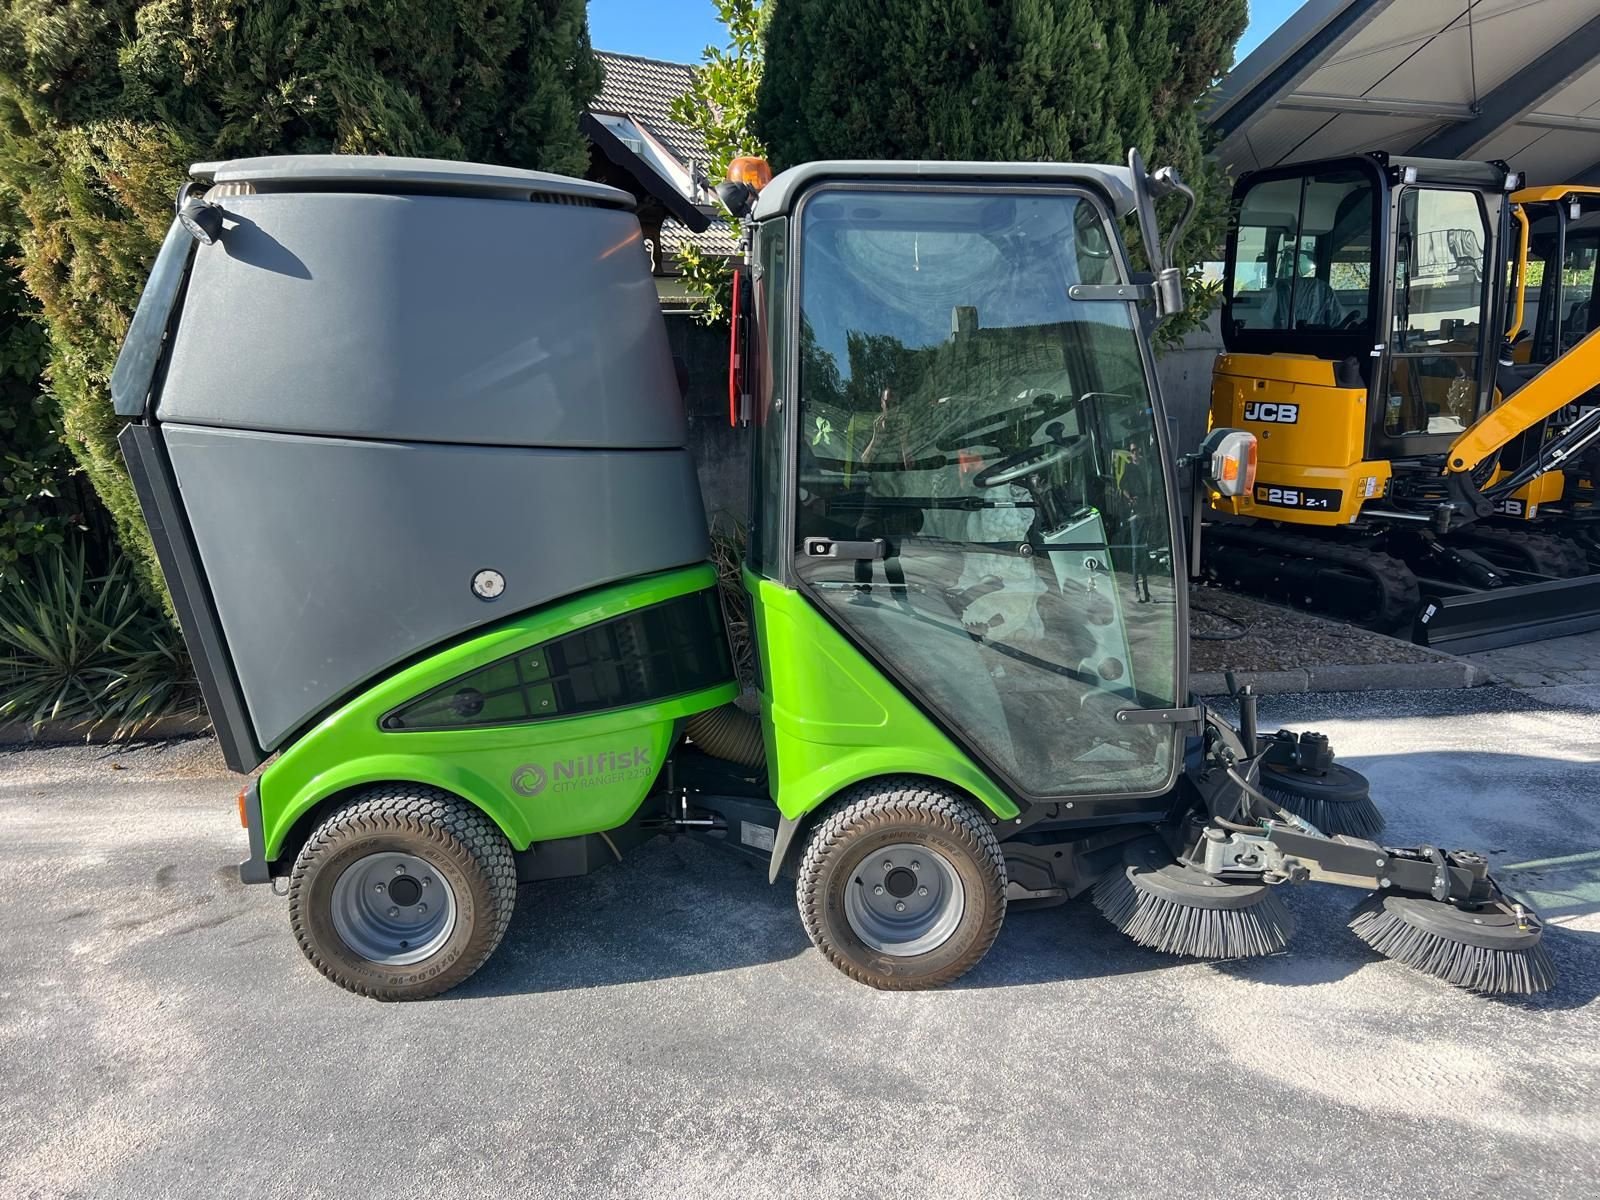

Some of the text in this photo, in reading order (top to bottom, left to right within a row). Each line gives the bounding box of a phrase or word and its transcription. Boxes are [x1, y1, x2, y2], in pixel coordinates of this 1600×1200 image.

[1244, 402, 1298, 423] JCB
[1268, 488, 1328, 507] 25 Z-1
[552, 746, 651, 781] Nilfisk
[552, 767, 652, 793] CITY RANGER 2250
